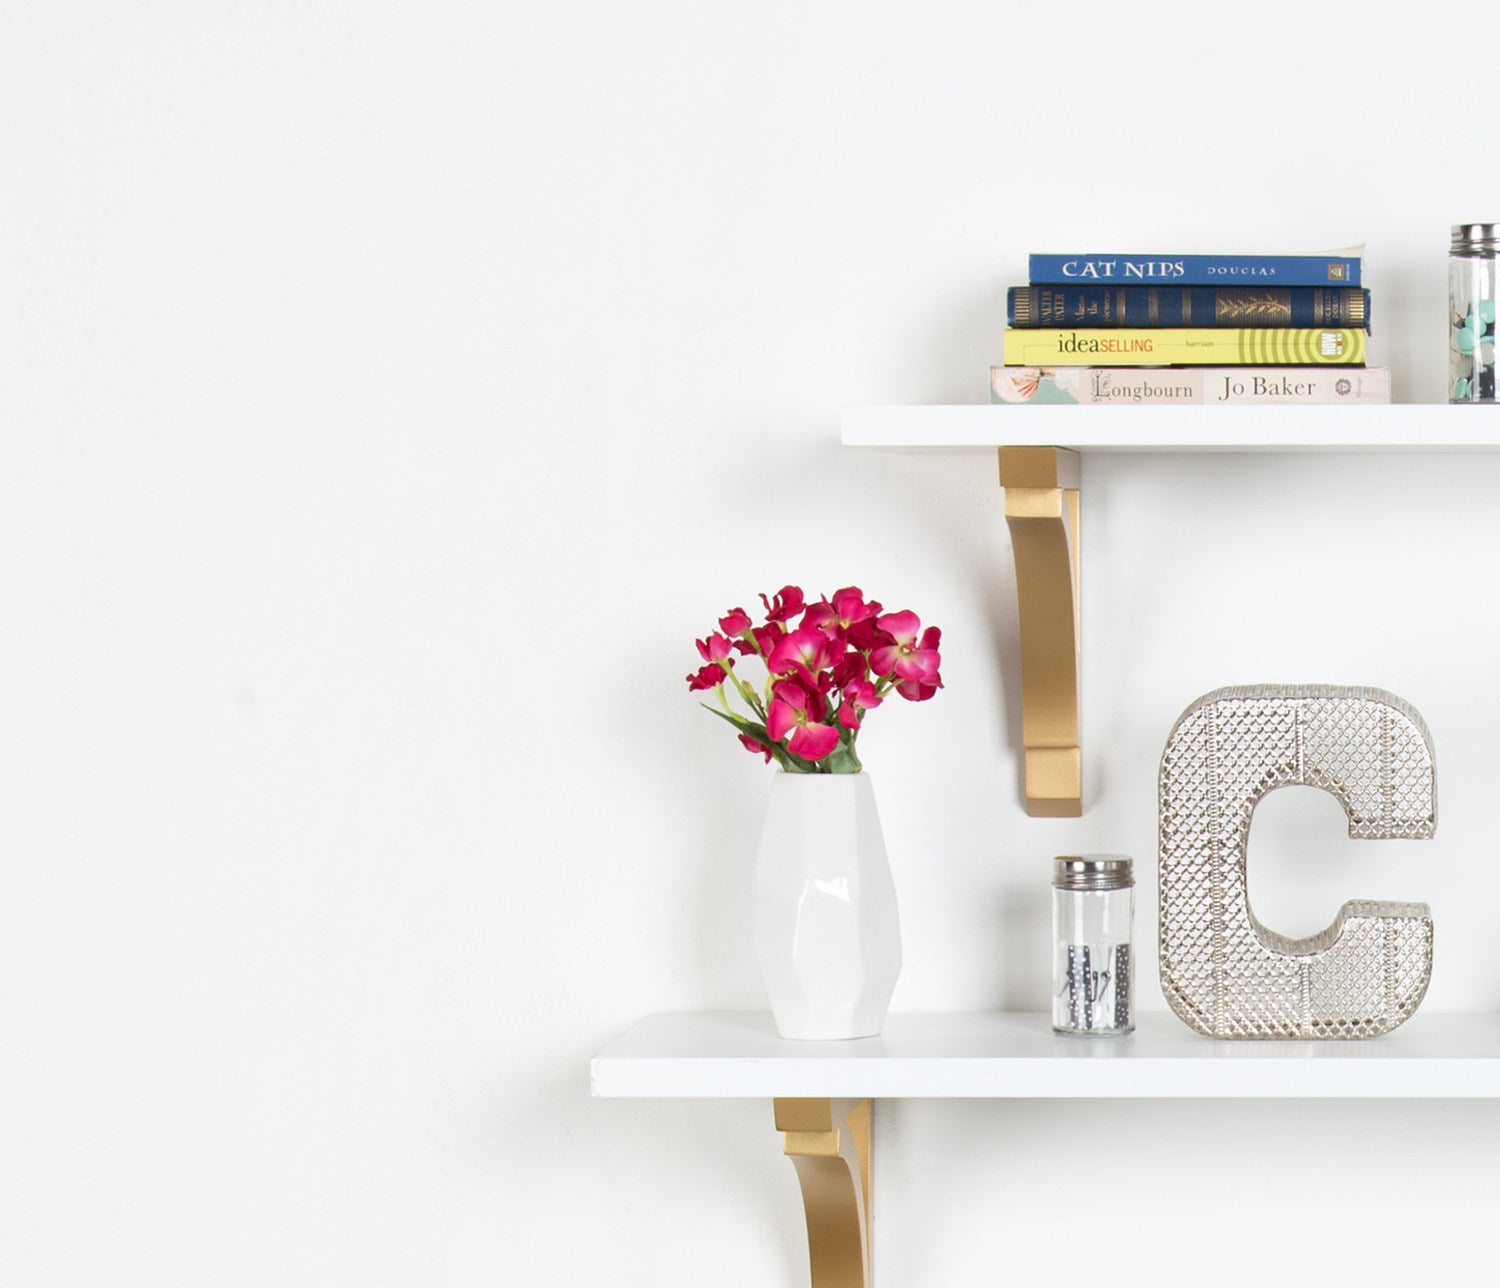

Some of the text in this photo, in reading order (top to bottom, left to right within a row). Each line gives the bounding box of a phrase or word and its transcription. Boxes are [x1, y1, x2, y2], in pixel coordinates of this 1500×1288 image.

[1062, 260, 1185, 278] CAT NIPS
[1207, 266, 1276, 276] DOUGLAS
[1054, 293, 1064, 320] PATER
[1185, 339, 1215, 348] harrison
[1321, 332, 1336, 355] HOW
[1092, 372, 1194, 402] Longbourn
[1218, 376, 1317, 401] Jo Baker
